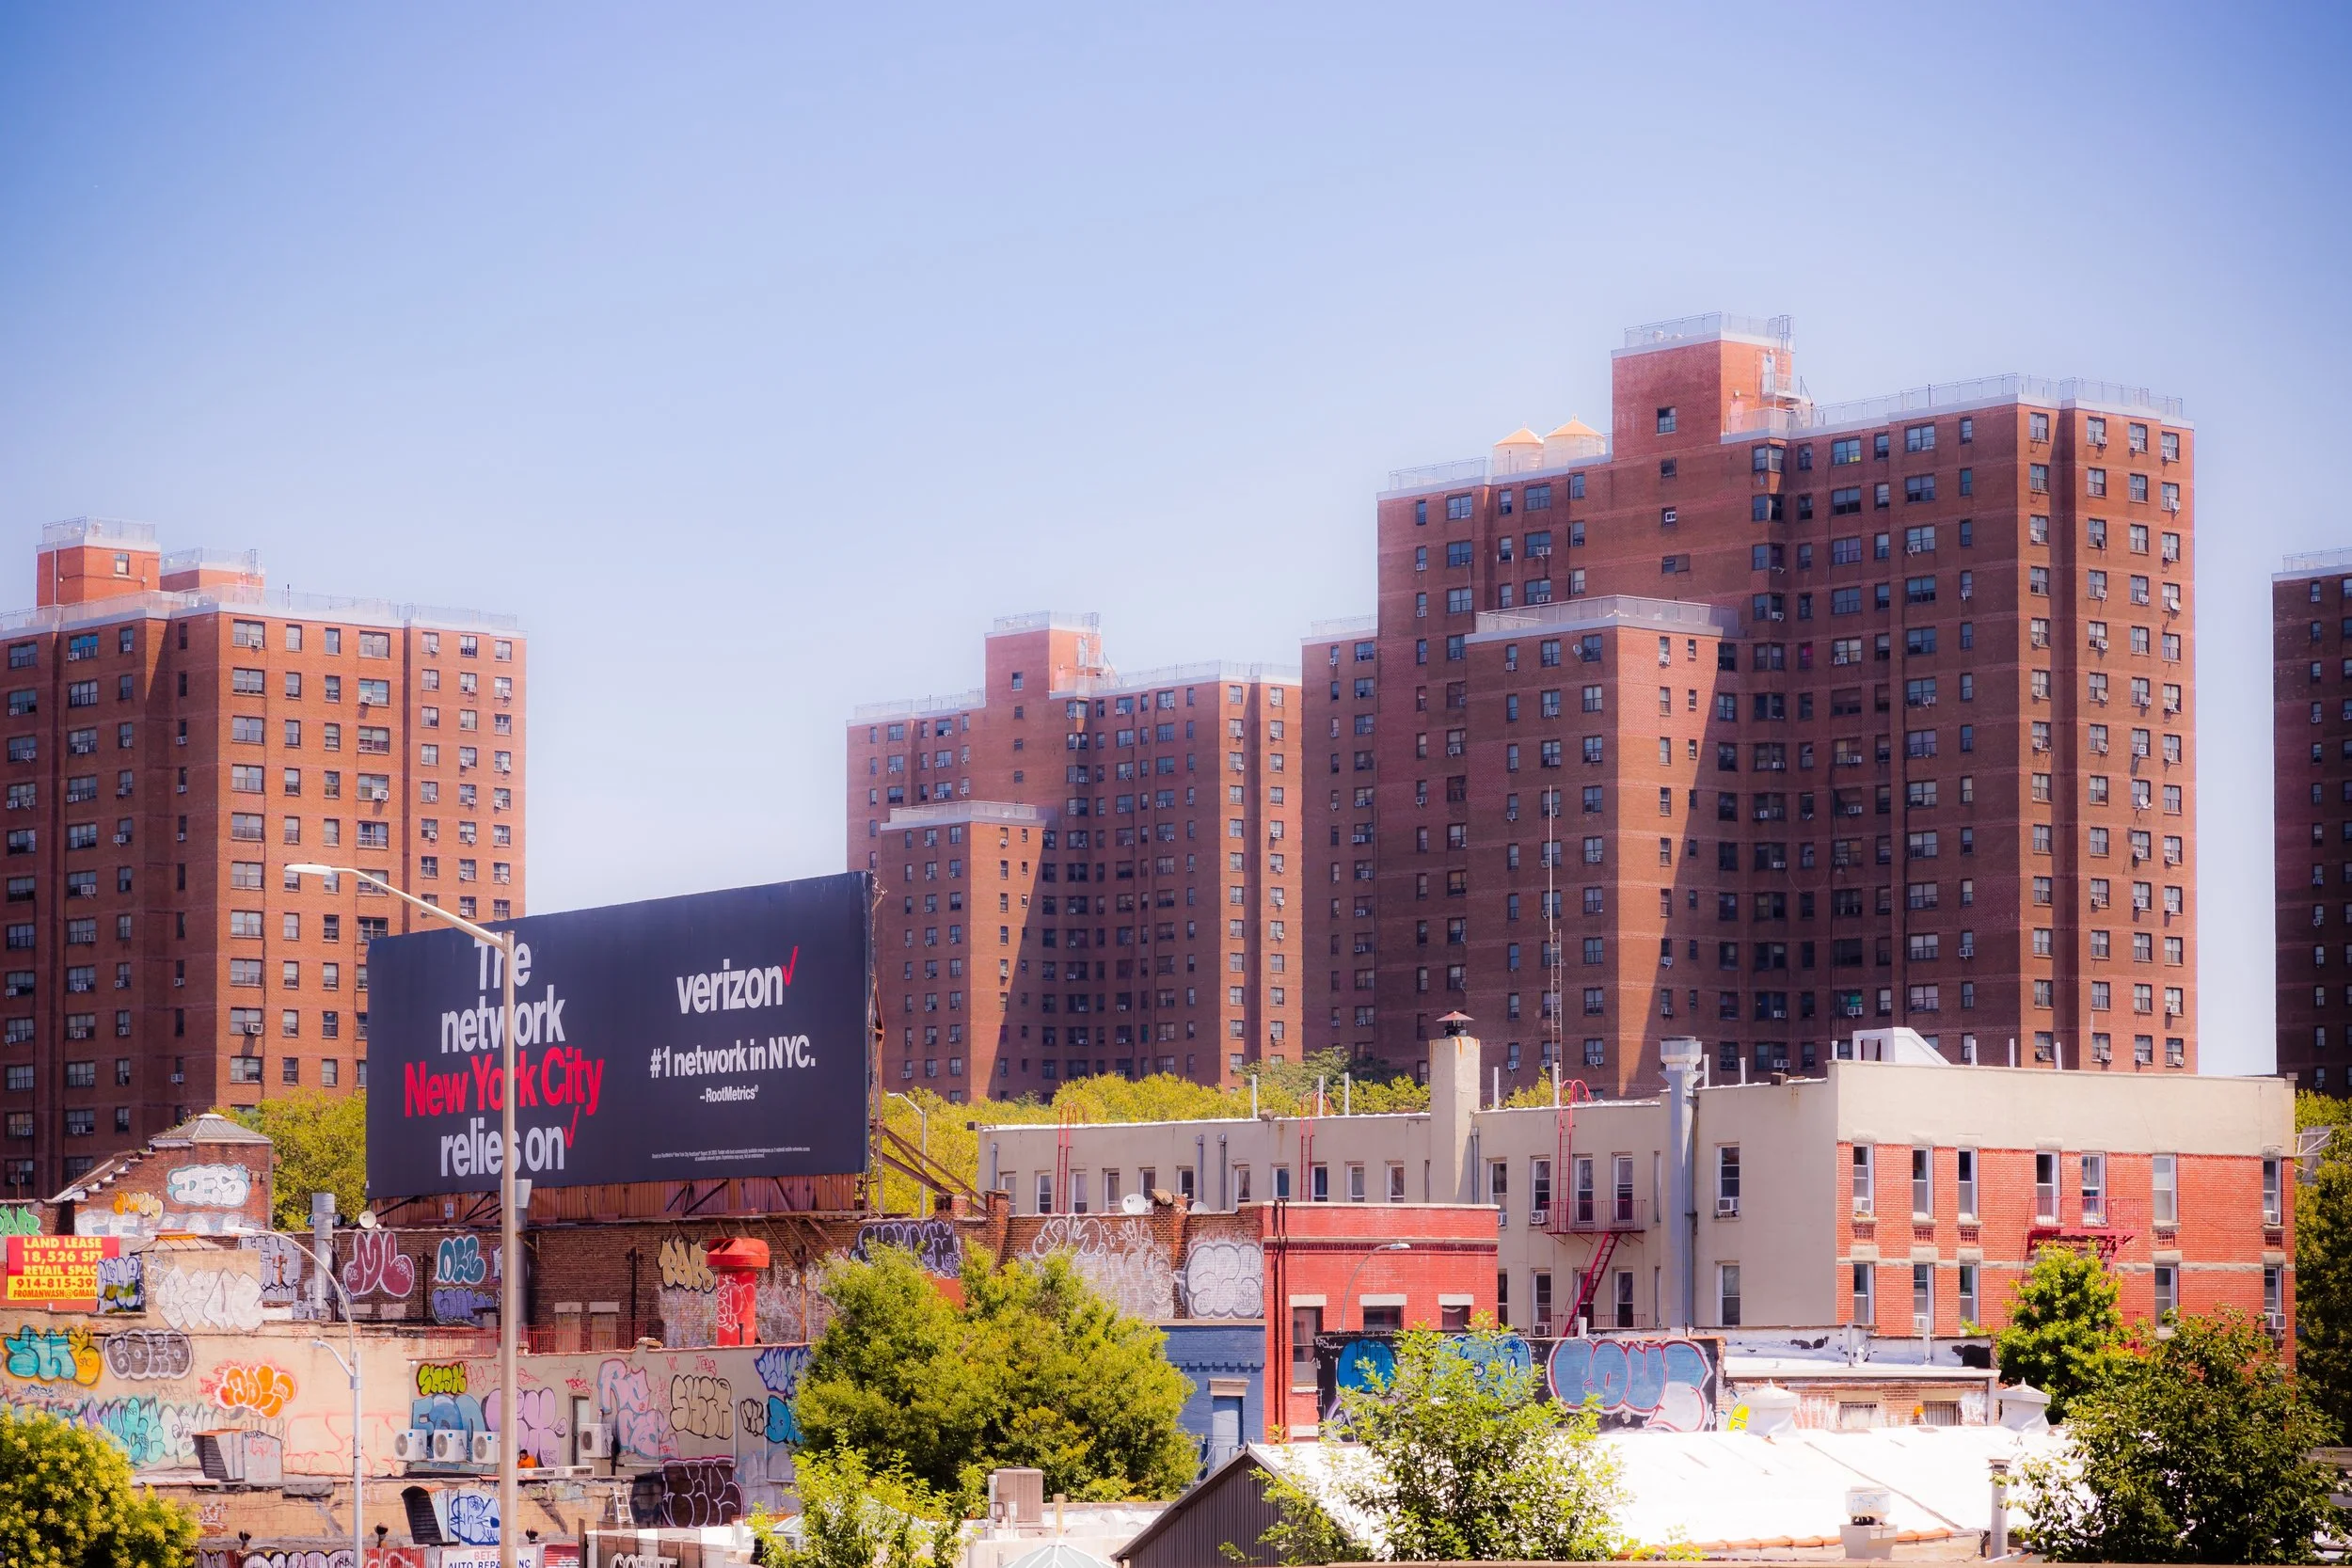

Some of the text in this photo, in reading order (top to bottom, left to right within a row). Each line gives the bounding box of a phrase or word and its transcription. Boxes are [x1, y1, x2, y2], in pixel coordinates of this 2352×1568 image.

[676, 958, 784, 1014] verizon
[441, 984, 566, 1053] network
[650, 1035, 817, 1078] #1 network in NYC.
[405, 1060, 469, 1117] New
[541, 1046, 605, 1117] City
[525, 1126, 565, 1172] on
[23, 1250, 103, 1264] 18,526 SFT
[24, 1237, 102, 1249] LAND LEASE
[24, 1264, 63, 1275] RETAIL
